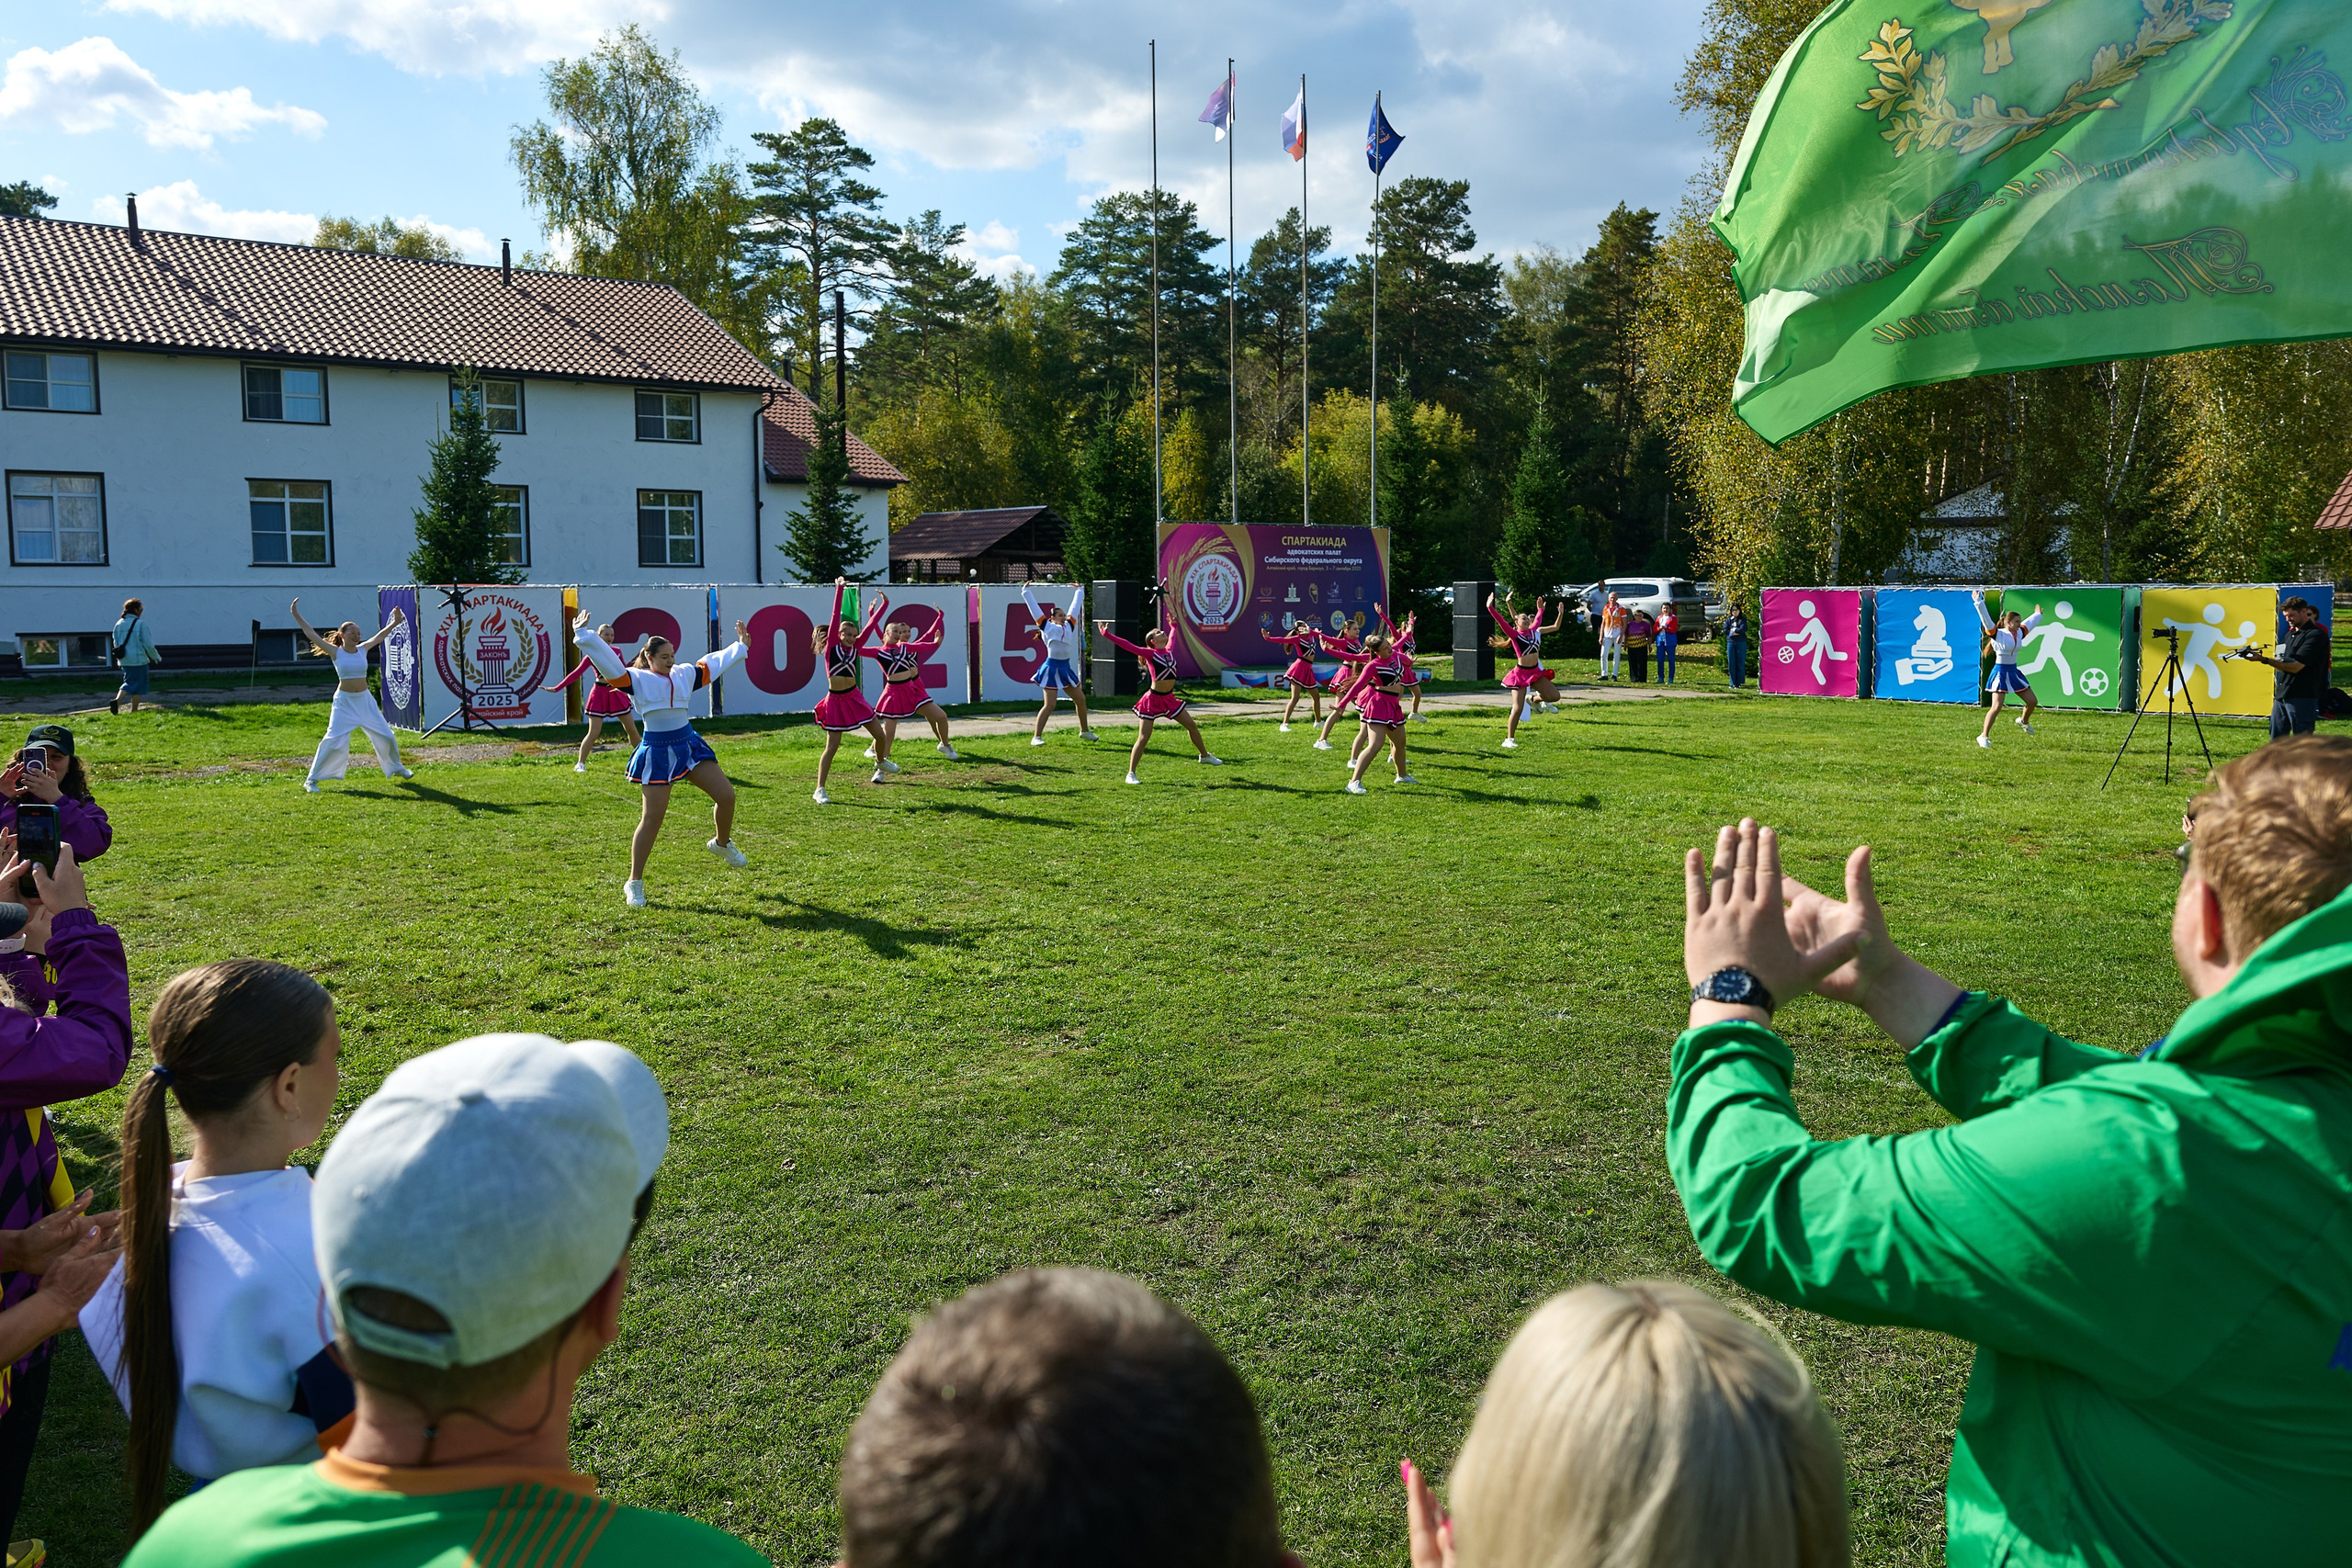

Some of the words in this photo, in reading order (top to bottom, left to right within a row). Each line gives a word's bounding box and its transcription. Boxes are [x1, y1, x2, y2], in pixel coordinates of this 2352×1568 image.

[1282, 536, 1347, 547] СПАРТАКИАДА
[1264, 556, 1300, 565] Сибирского
[1301, 557, 1342, 566] федерального
[1343, 558, 1363, 566] округа
[1198, 558, 1238, 581] СПАРТАКИАДА
[460, 594, 544, 633] ПАРТАКИАДА
[438, 614, 458, 635] XIX
[452, 682, 471, 699] палт
[478, 695, 513, 706] 2025
[469, 709, 505, 717] Атайский
[506, 708, 524, 717] край
